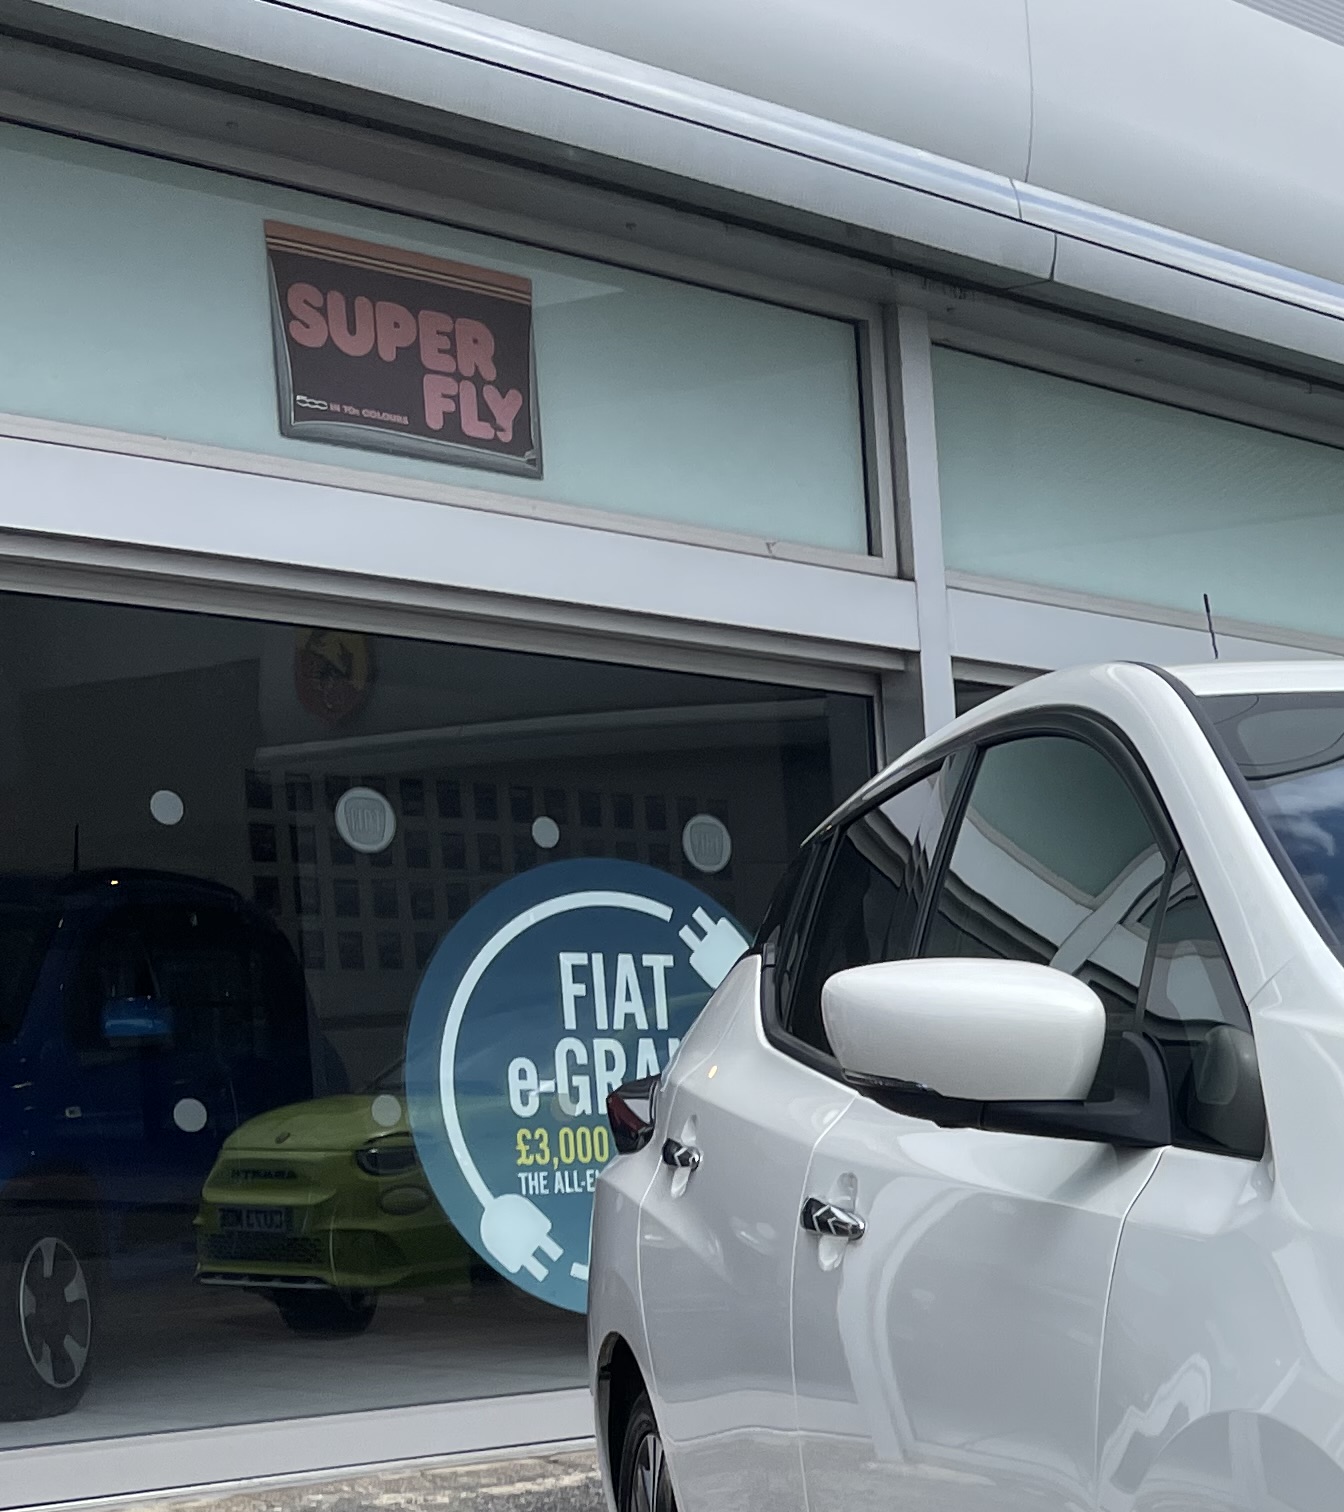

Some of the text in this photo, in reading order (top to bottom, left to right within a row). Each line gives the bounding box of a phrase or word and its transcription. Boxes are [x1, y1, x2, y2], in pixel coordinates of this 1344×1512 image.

[286, 281, 497, 382] SUPER
[422, 372, 523, 443] FLY
[558, 951, 676, 1031] FIAT
[516, 1126, 610, 1170] £3,000
[518, 1172, 550, 1196] THE
